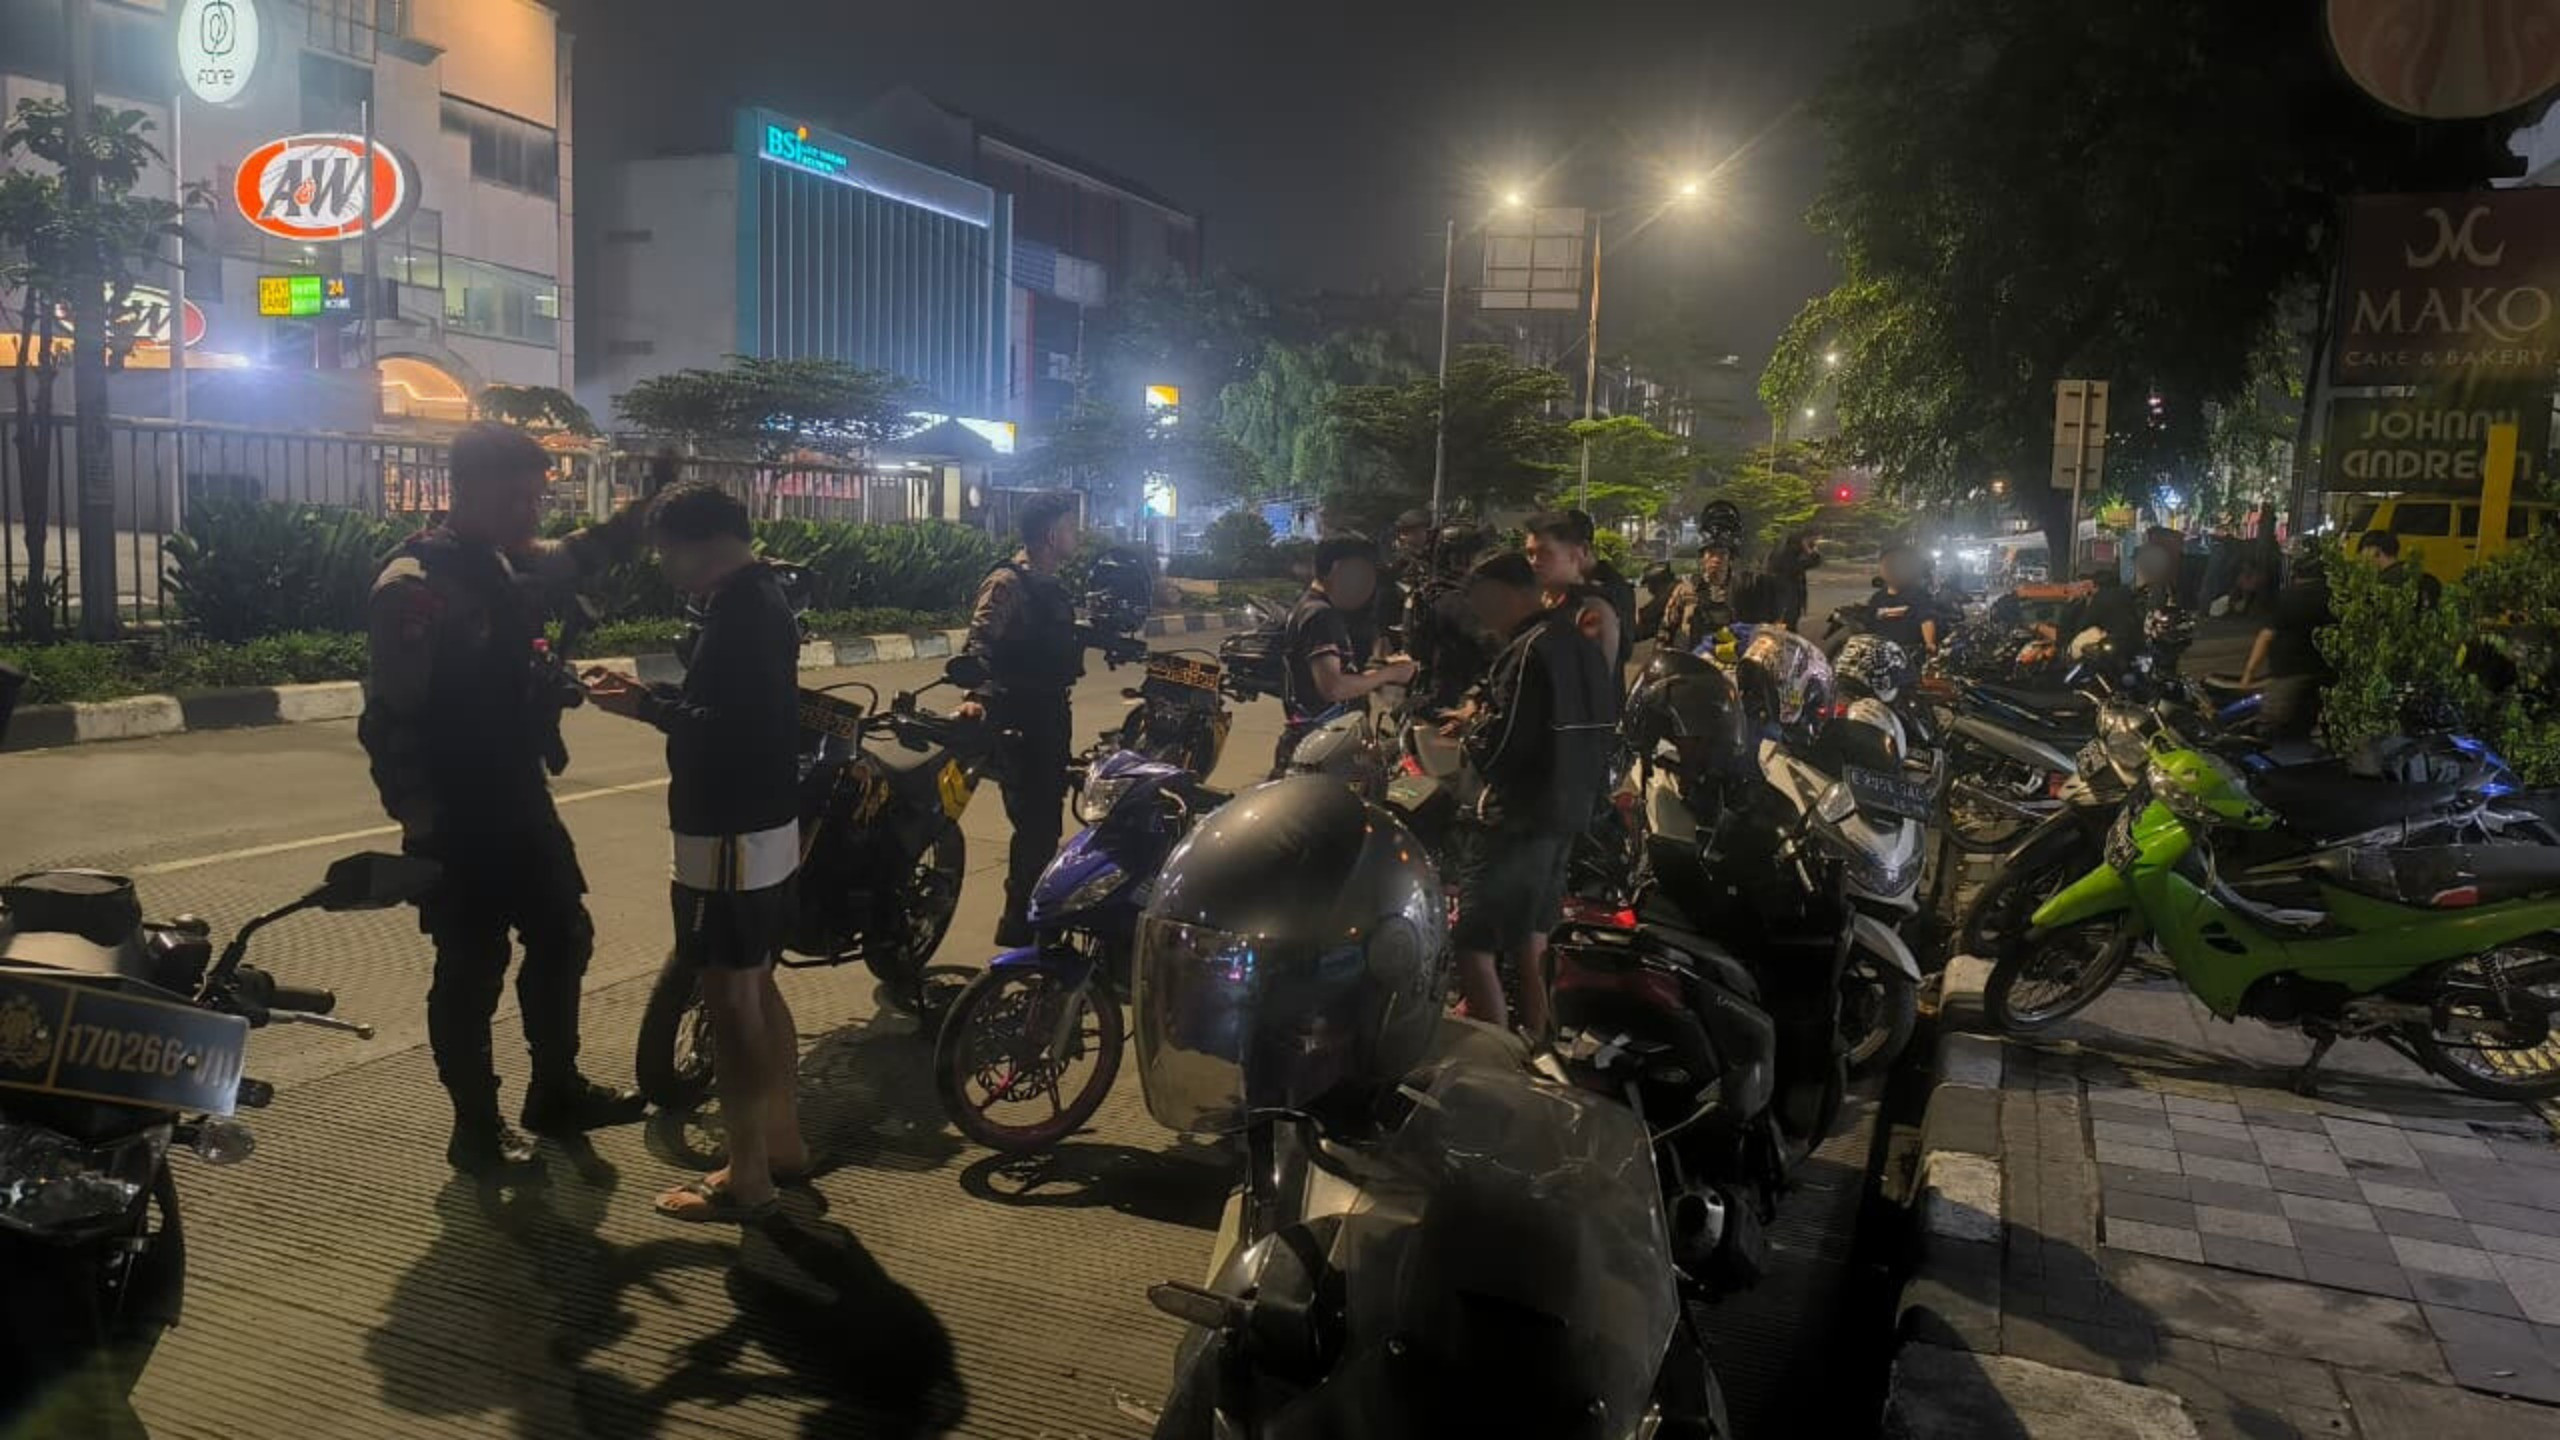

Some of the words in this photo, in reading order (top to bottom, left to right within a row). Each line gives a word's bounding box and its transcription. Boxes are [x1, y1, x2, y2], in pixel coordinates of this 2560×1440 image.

[260, 157, 366, 217] A&W
[2351, 286, 2552, 342] MAKO
[2346, 350, 2409, 367] CAKE
[2420, 350, 2435, 367] &
[2446, 349, 2547, 370] BAKERY
